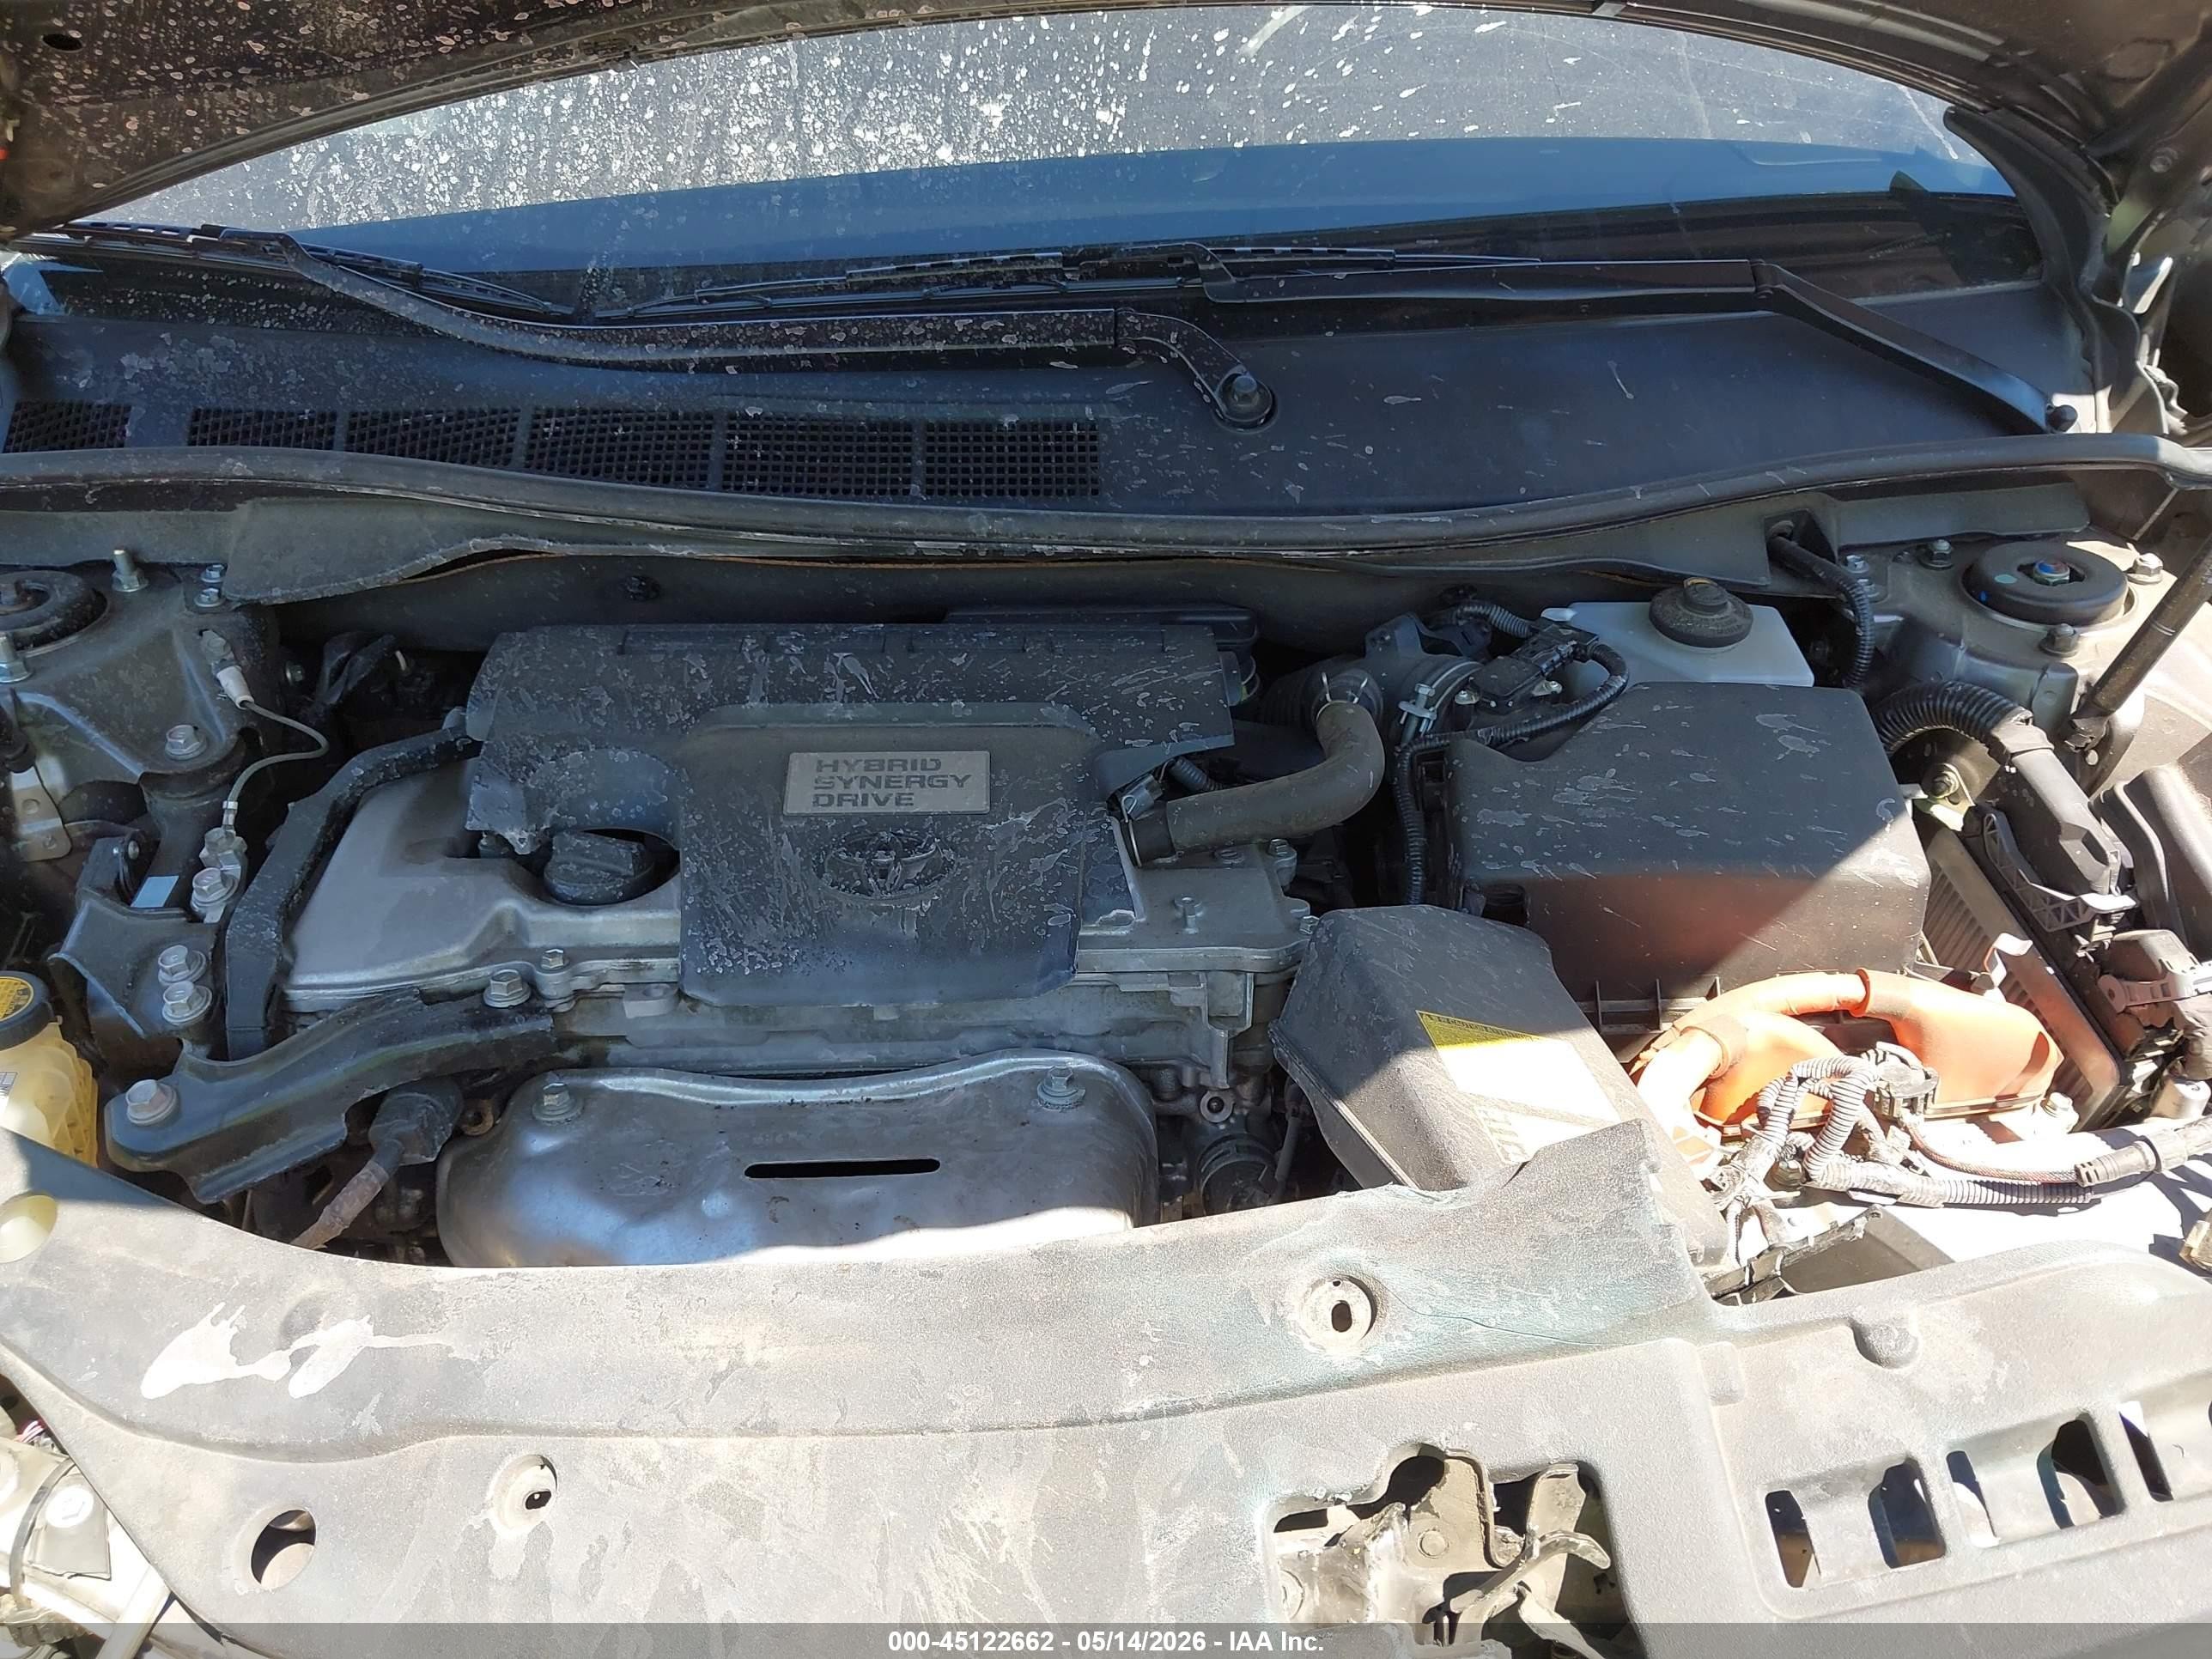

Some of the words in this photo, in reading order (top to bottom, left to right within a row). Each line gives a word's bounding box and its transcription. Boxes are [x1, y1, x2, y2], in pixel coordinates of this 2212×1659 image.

[817, 758, 942, 773] HYBRID
[813, 775, 972, 790] SYNERGY
[811, 793, 915, 807] DRIVE
